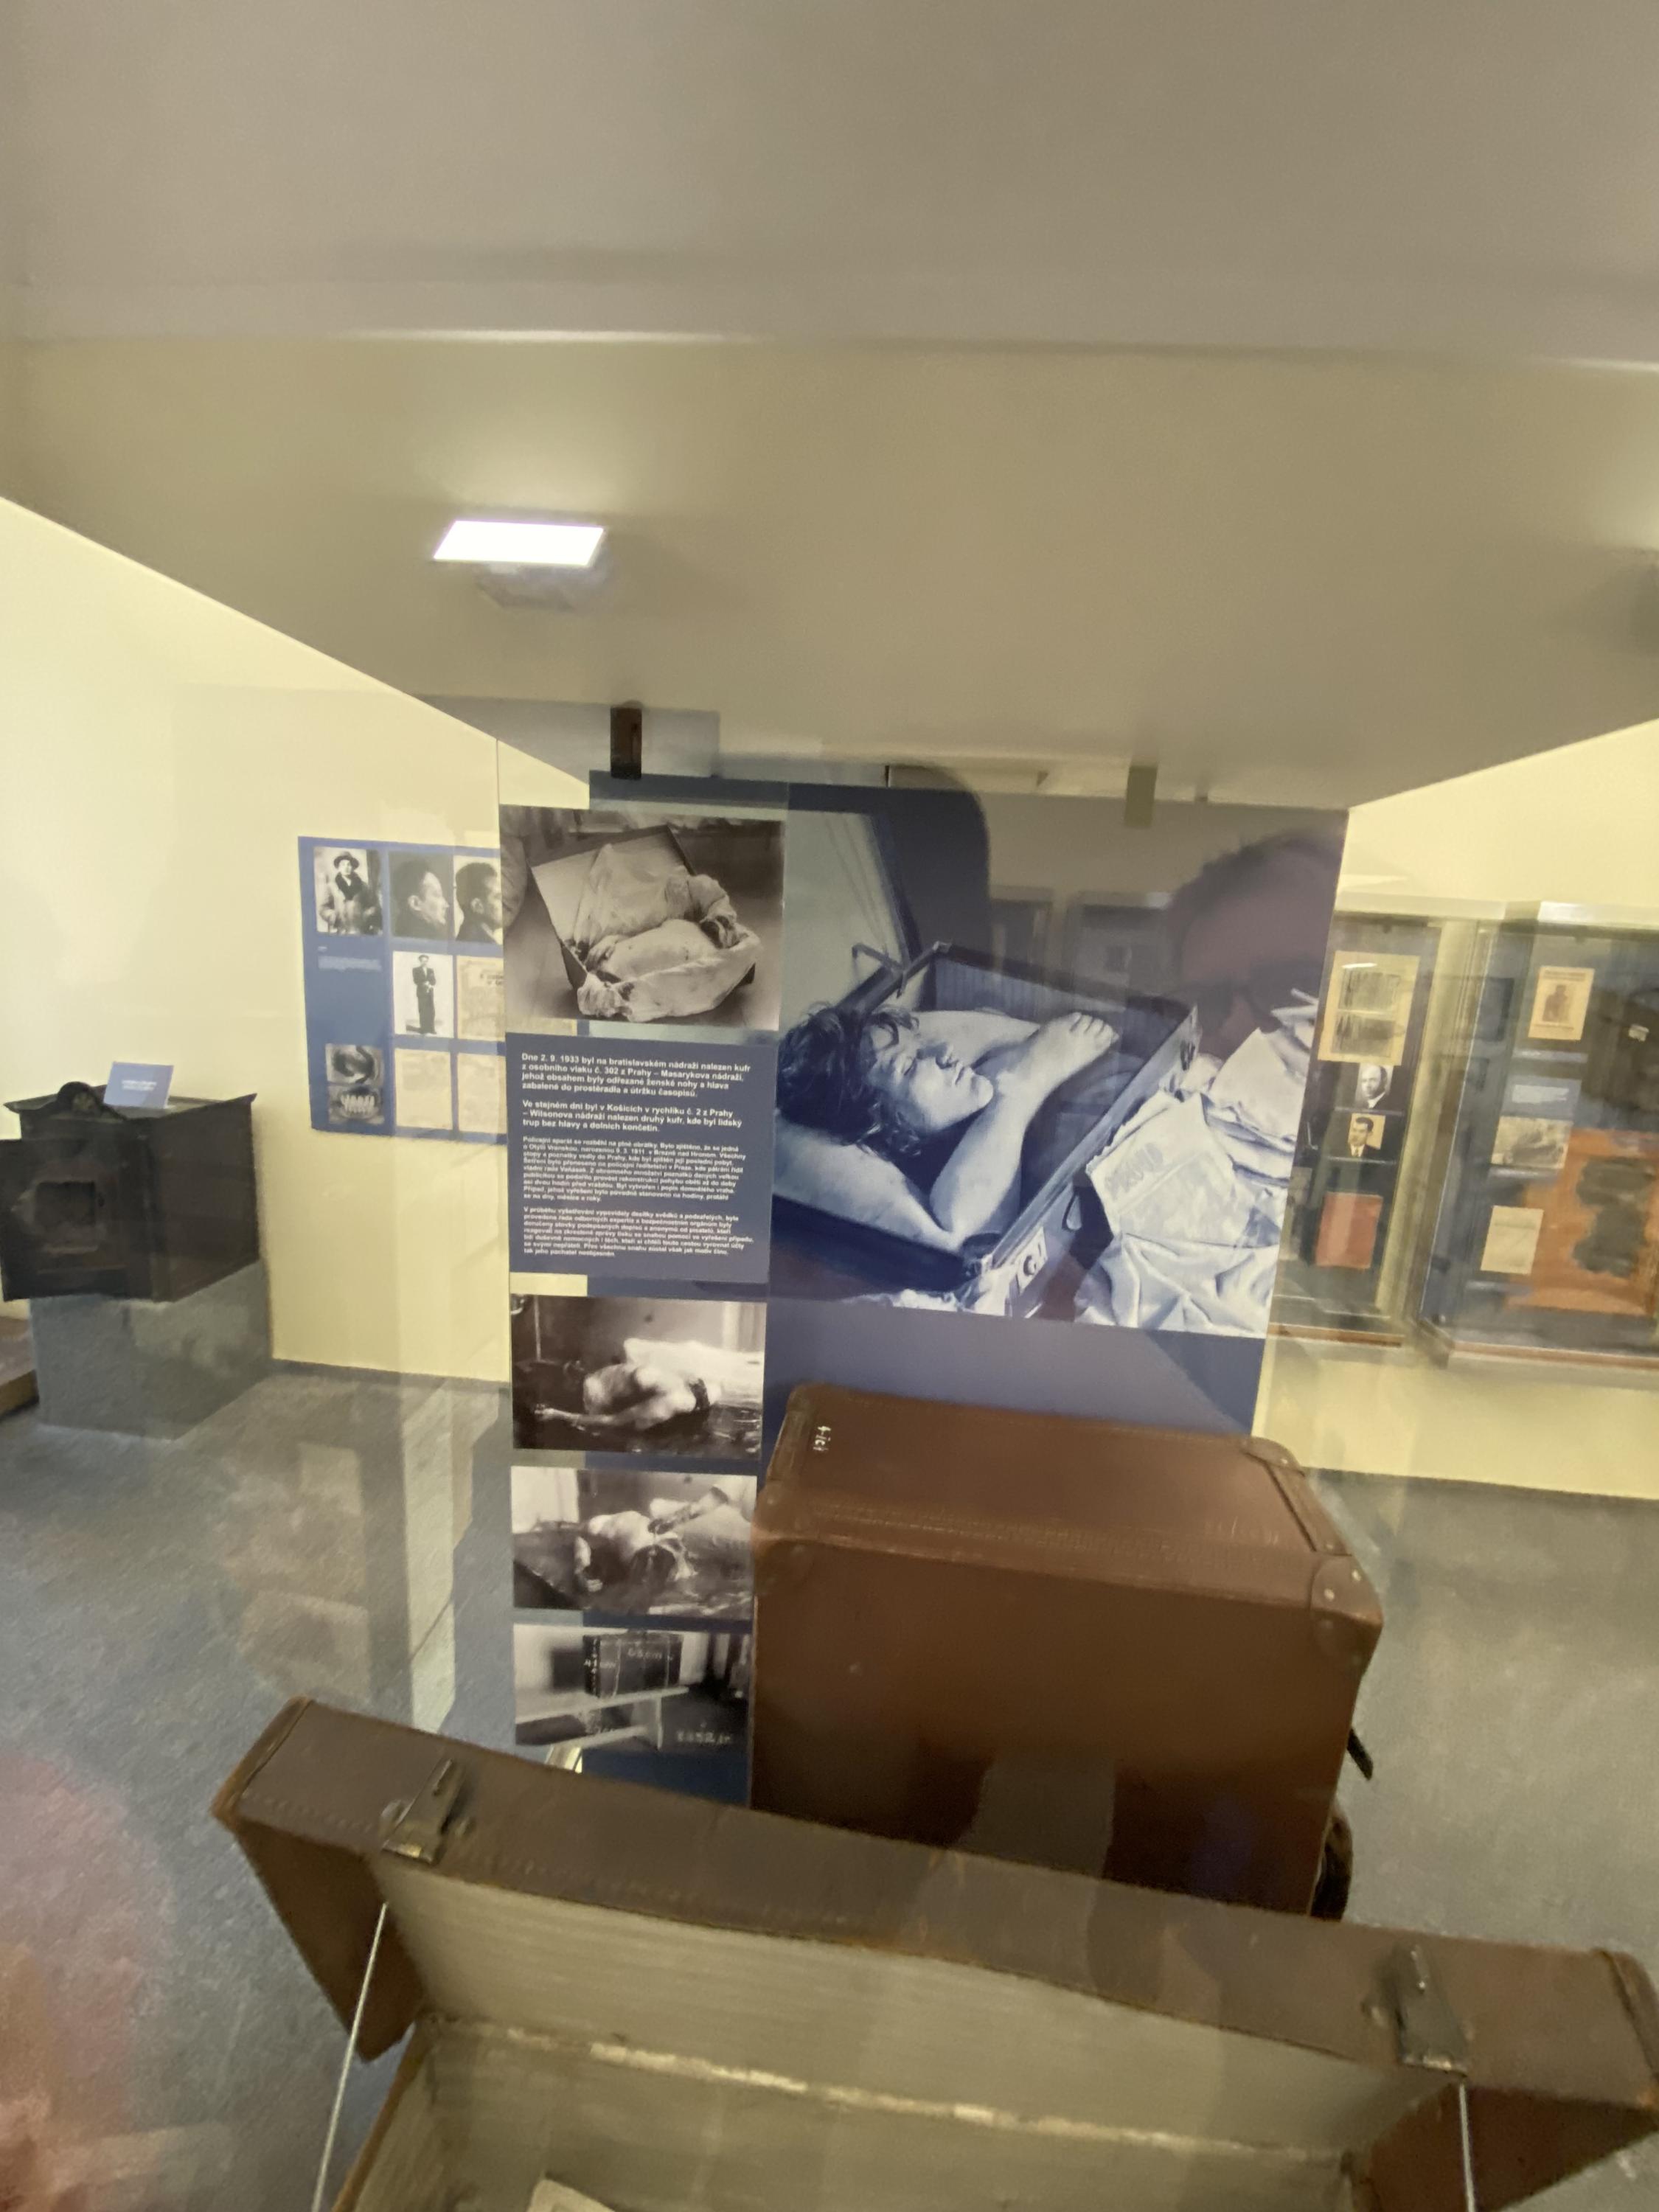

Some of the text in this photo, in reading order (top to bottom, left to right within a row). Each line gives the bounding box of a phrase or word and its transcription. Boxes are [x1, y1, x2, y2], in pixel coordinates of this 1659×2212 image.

[522, 1053, 538, 1061] Dne
[560, 1055, 579, 1063] 1933
[582, 1056, 594, 1066] byl
[609, 1057, 666, 1068] bratislavském
[669, 1060, 698, 1069] nádraží
[701, 1062, 731, 1071] nalezen
[734, 1063, 750, 1072] kufr
[522, 1071, 543, 1082] jehož
[547, 1073, 584, 1082] obsahem
[588, 1074, 603, 1085] byly
[607, 1075, 644, 1085] odřezané
[647, 1077, 675, 1087] ženské
[678, 1079, 697, 1090] nohy
[707, 1081, 728, 1089] hlava
[529, 1062, 567, 1072] osobního
[570, 1065, 591, 1074] vlaku
[605, 1066, 618, 1074] 302
[628, 1068, 651, 1078] Prahy
[661, 1069, 709, 1081] Masarykova
[712, 1071, 743, 1083] nádraží,
[522, 1081, 558, 1091] zabalené
[561, 1083, 571, 1091] do
[574, 1083, 620, 1096] prostěradla
[630, 1086, 655, 1095] útržku
[658, 1088, 697, 1099] časopisů.
[523, 1099, 532, 1107] Ve
[535, 1099, 567, 1110] stejném
[570, 1102, 582, 1110] dni
[585, 1102, 597, 1112] byl
[607, 1103, 641, 1113] Košicích
[653, 1105, 684, 1116] rychlíku
[710, 1108, 732, 1119] Prahy
[523, 1118, 539, 1128] trup
[542, 1119, 555, 1127] bez
[559, 1119, 580, 1130] hlavy
[591, 1121, 619, 1130] dolních
[623, 1122, 658, 1132] končetin.
[531, 1109, 572, 1119] Wilsonova
[575, 1110, 605, 1120] nádraží
[608, 1113, 638, 1121] nalezen
[641, 1114, 664, 1125] druhý
[667, 1116, 684, 1126] kufr,
[687, 1116, 700, 1125] kde
[704, 1118, 715, 1127] byl
[719, 1118, 741, 1129] lidský
